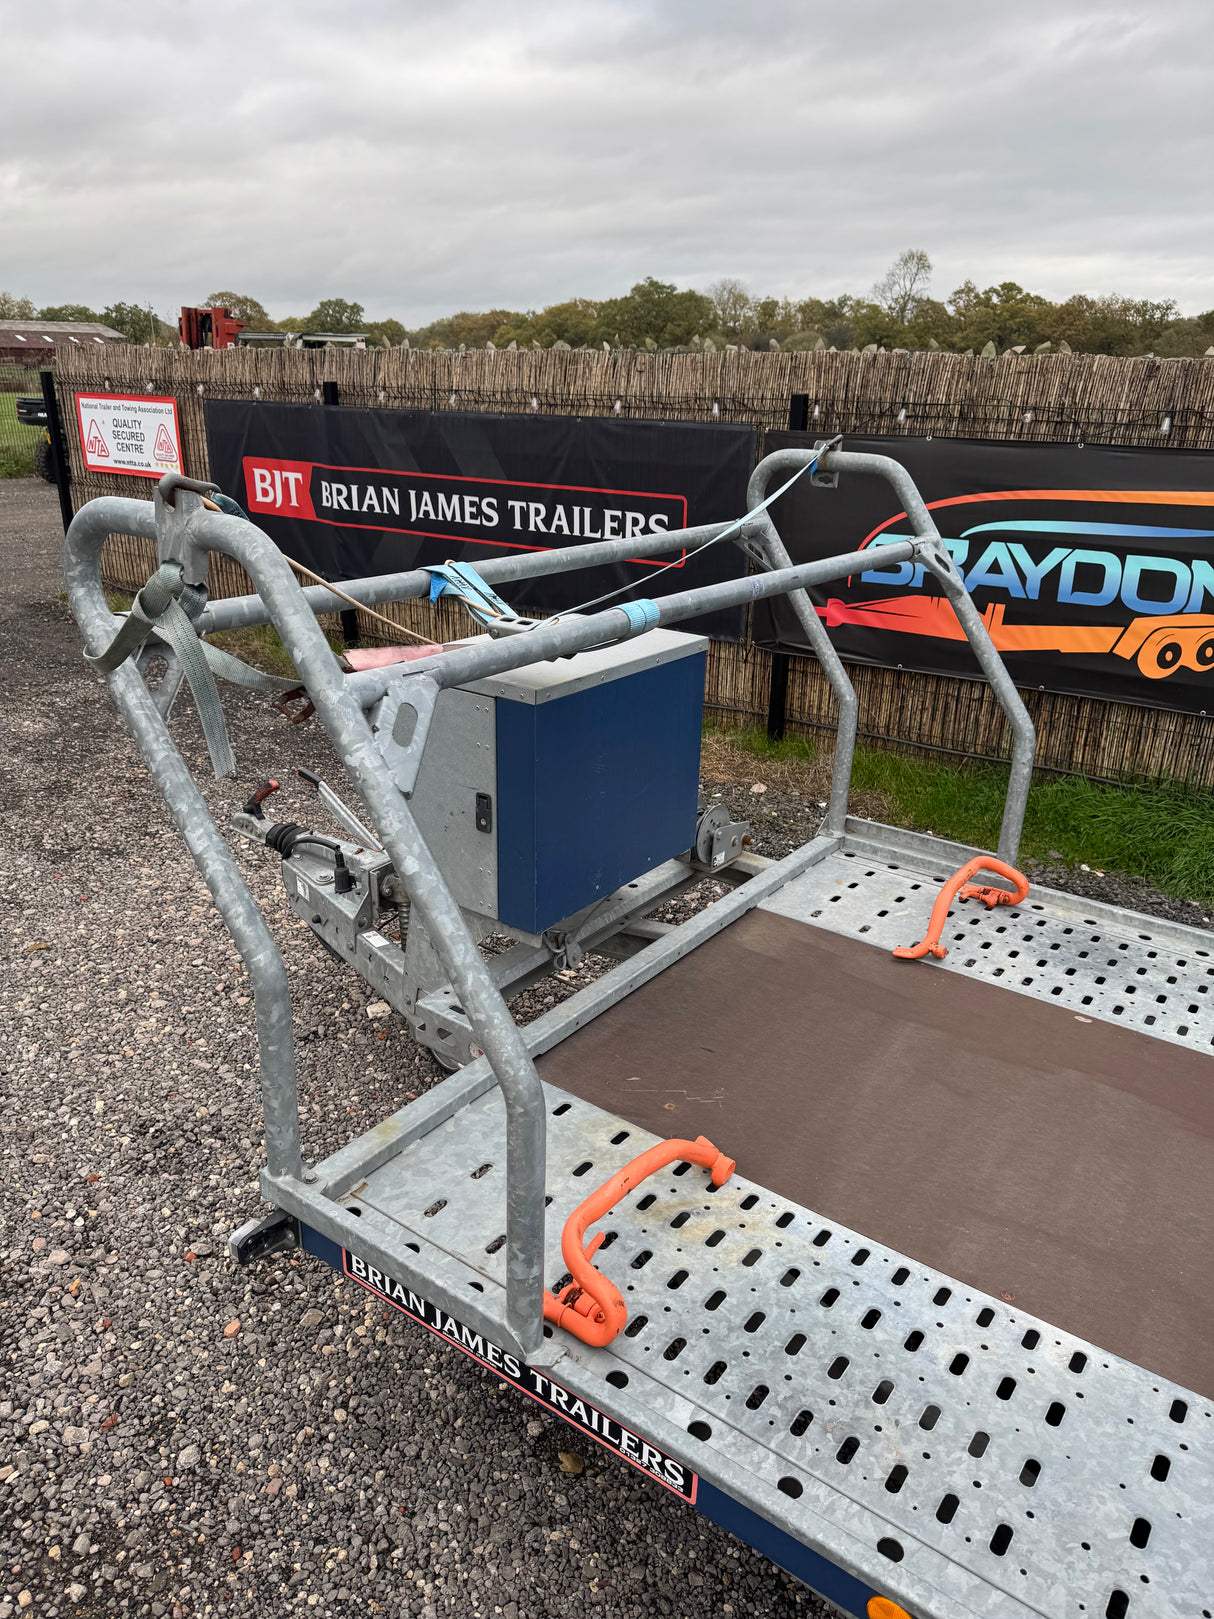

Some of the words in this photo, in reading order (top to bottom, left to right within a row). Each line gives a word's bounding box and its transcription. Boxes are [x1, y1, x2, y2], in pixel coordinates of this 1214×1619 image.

[122, 405, 138, 414] Towing
[138, 406, 164, 414] Association
[112, 418, 141, 429] QUALITY
[112, 430, 145, 442] SECURED
[116, 442, 144, 454] CENTRE
[113, 459, 151, 468] www.ntta.co.uk
[252, 468, 303, 508] BJT
[321, 481, 400, 515] BRIAN
[408, 489, 499, 527] JAMES
[507, 500, 669, 540] TRAILERS
[351, 1253, 425, 1318] BRIAN
[431, 1307, 521, 1379] JAMES
[530, 1369, 684, 1487] TRAILERS
